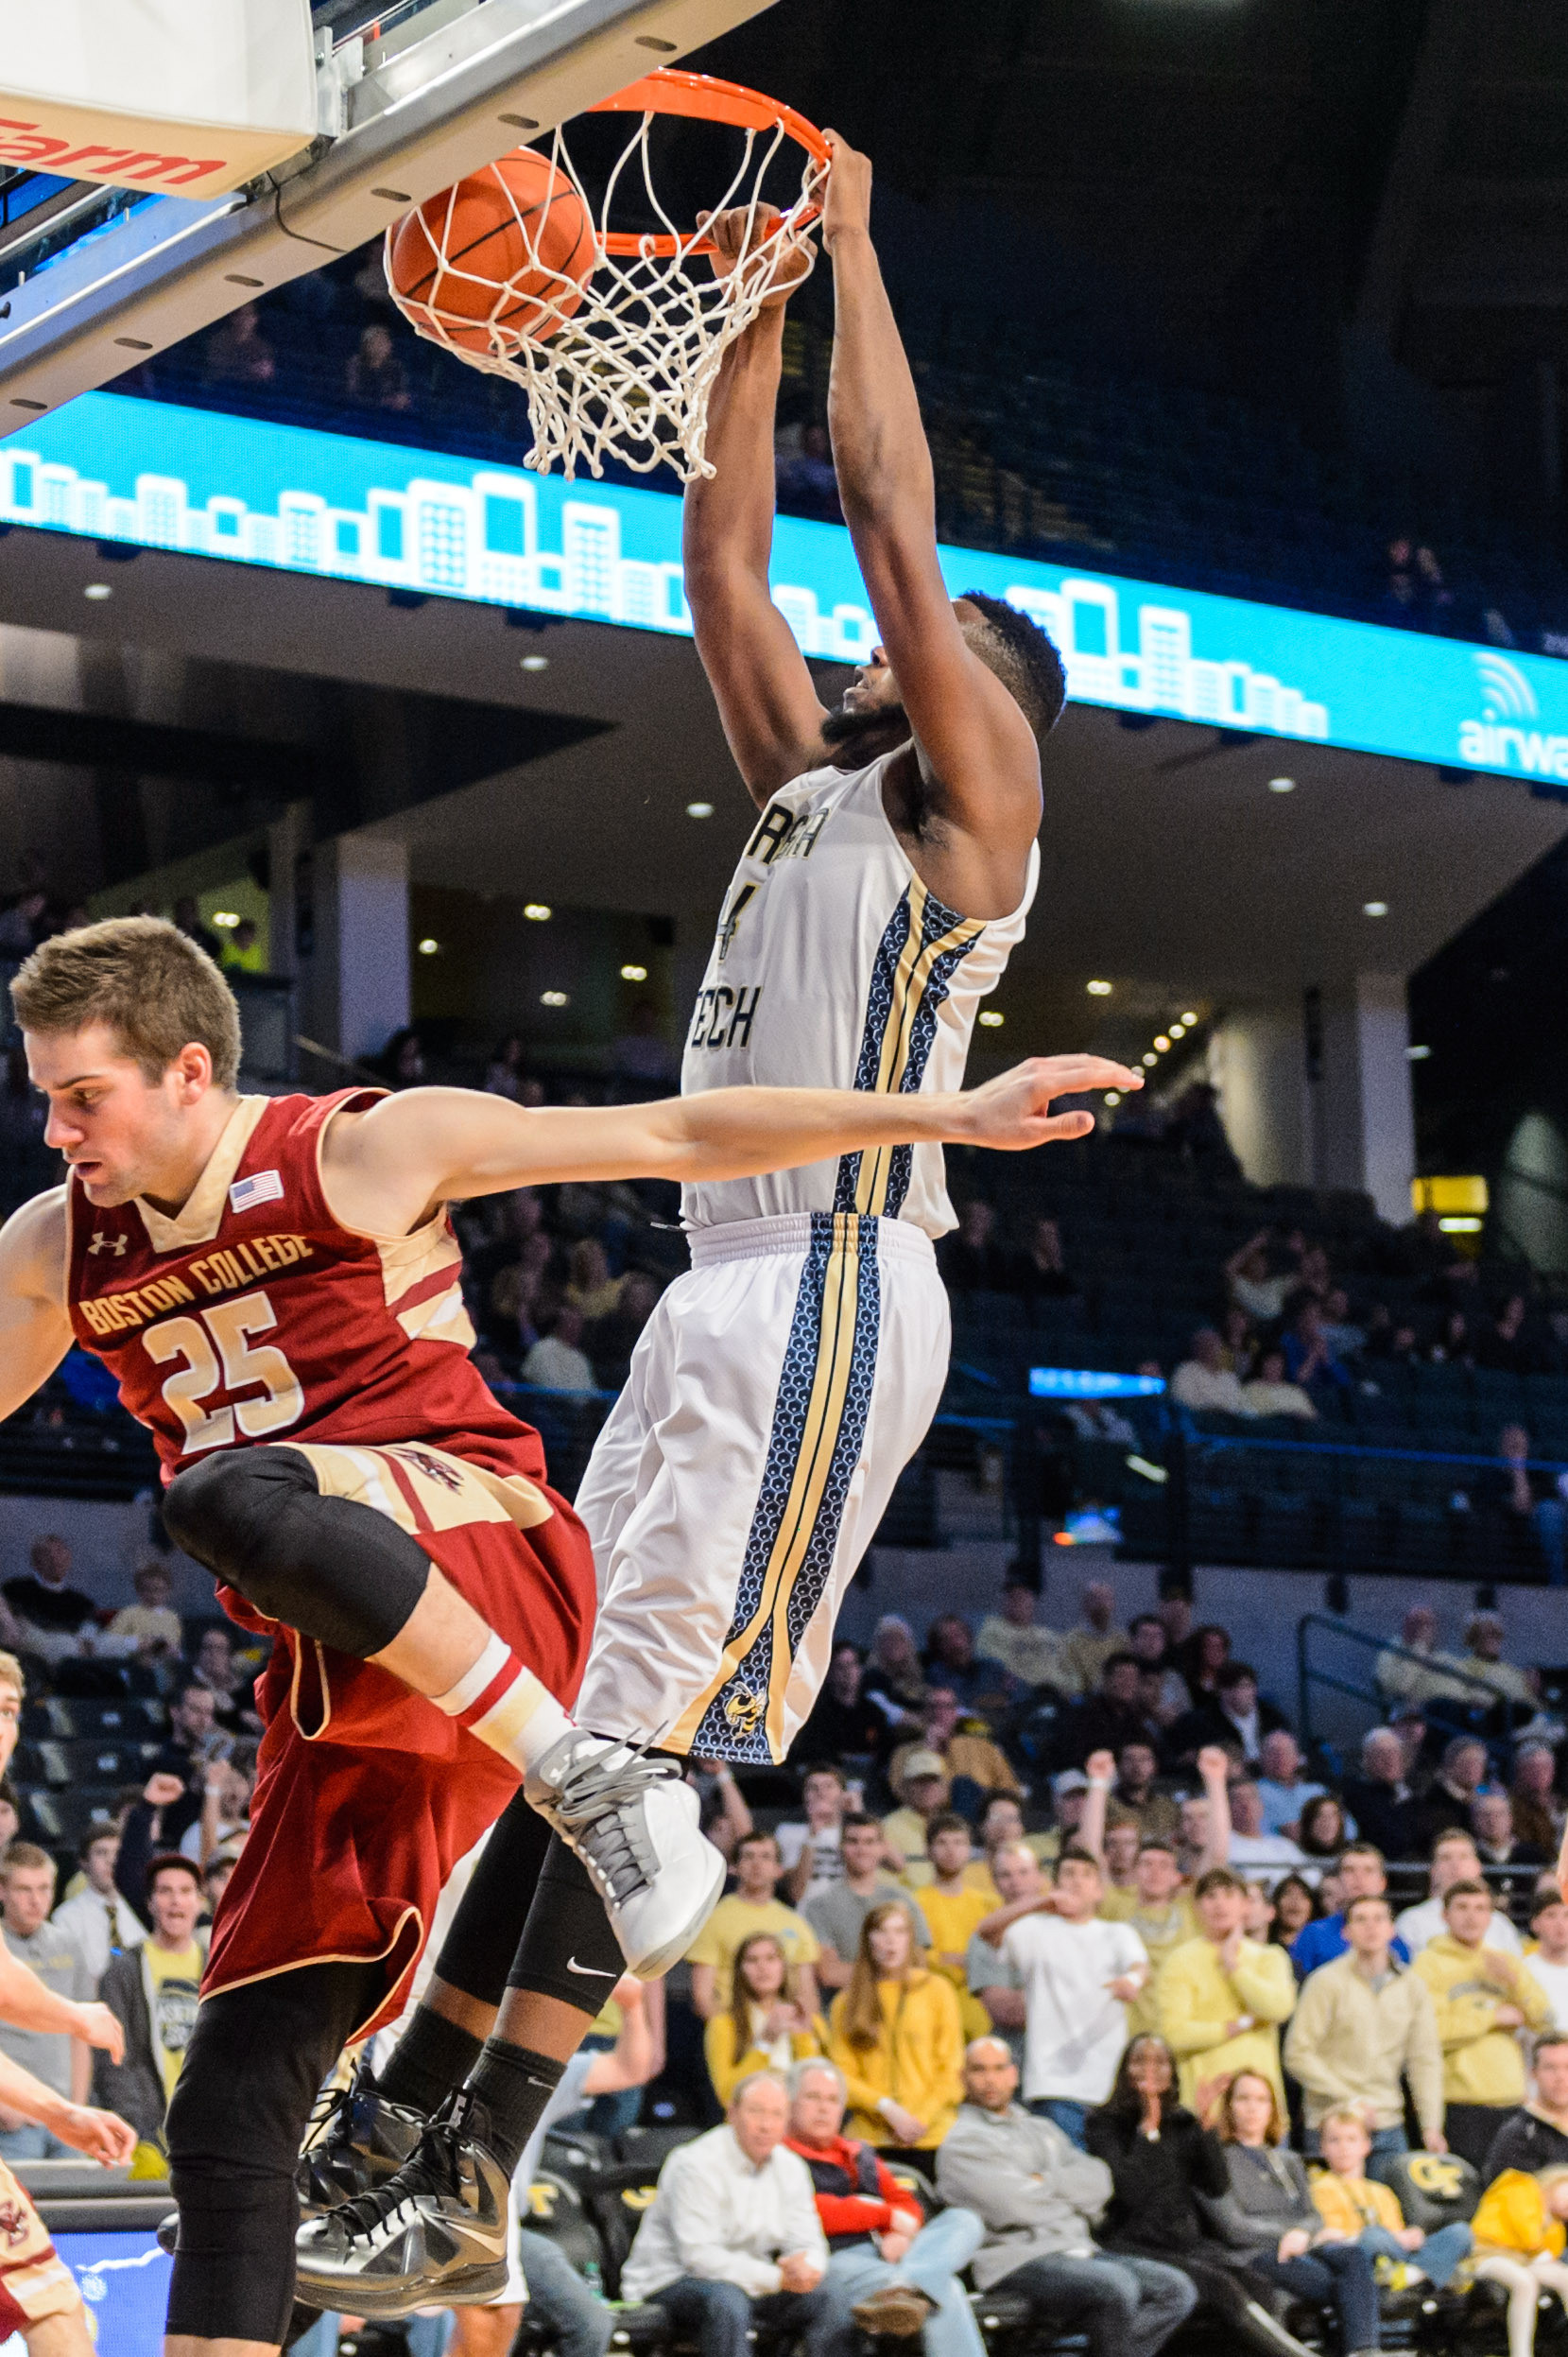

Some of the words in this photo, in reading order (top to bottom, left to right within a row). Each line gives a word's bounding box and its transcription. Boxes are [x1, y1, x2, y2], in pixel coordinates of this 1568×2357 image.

[690, 985, 764, 1050] ECH
[78, 1274, 196, 1335] BOSTON
[188, 1234, 314, 1295] COLLEGE
[142, 1291, 305, 1455] 25
